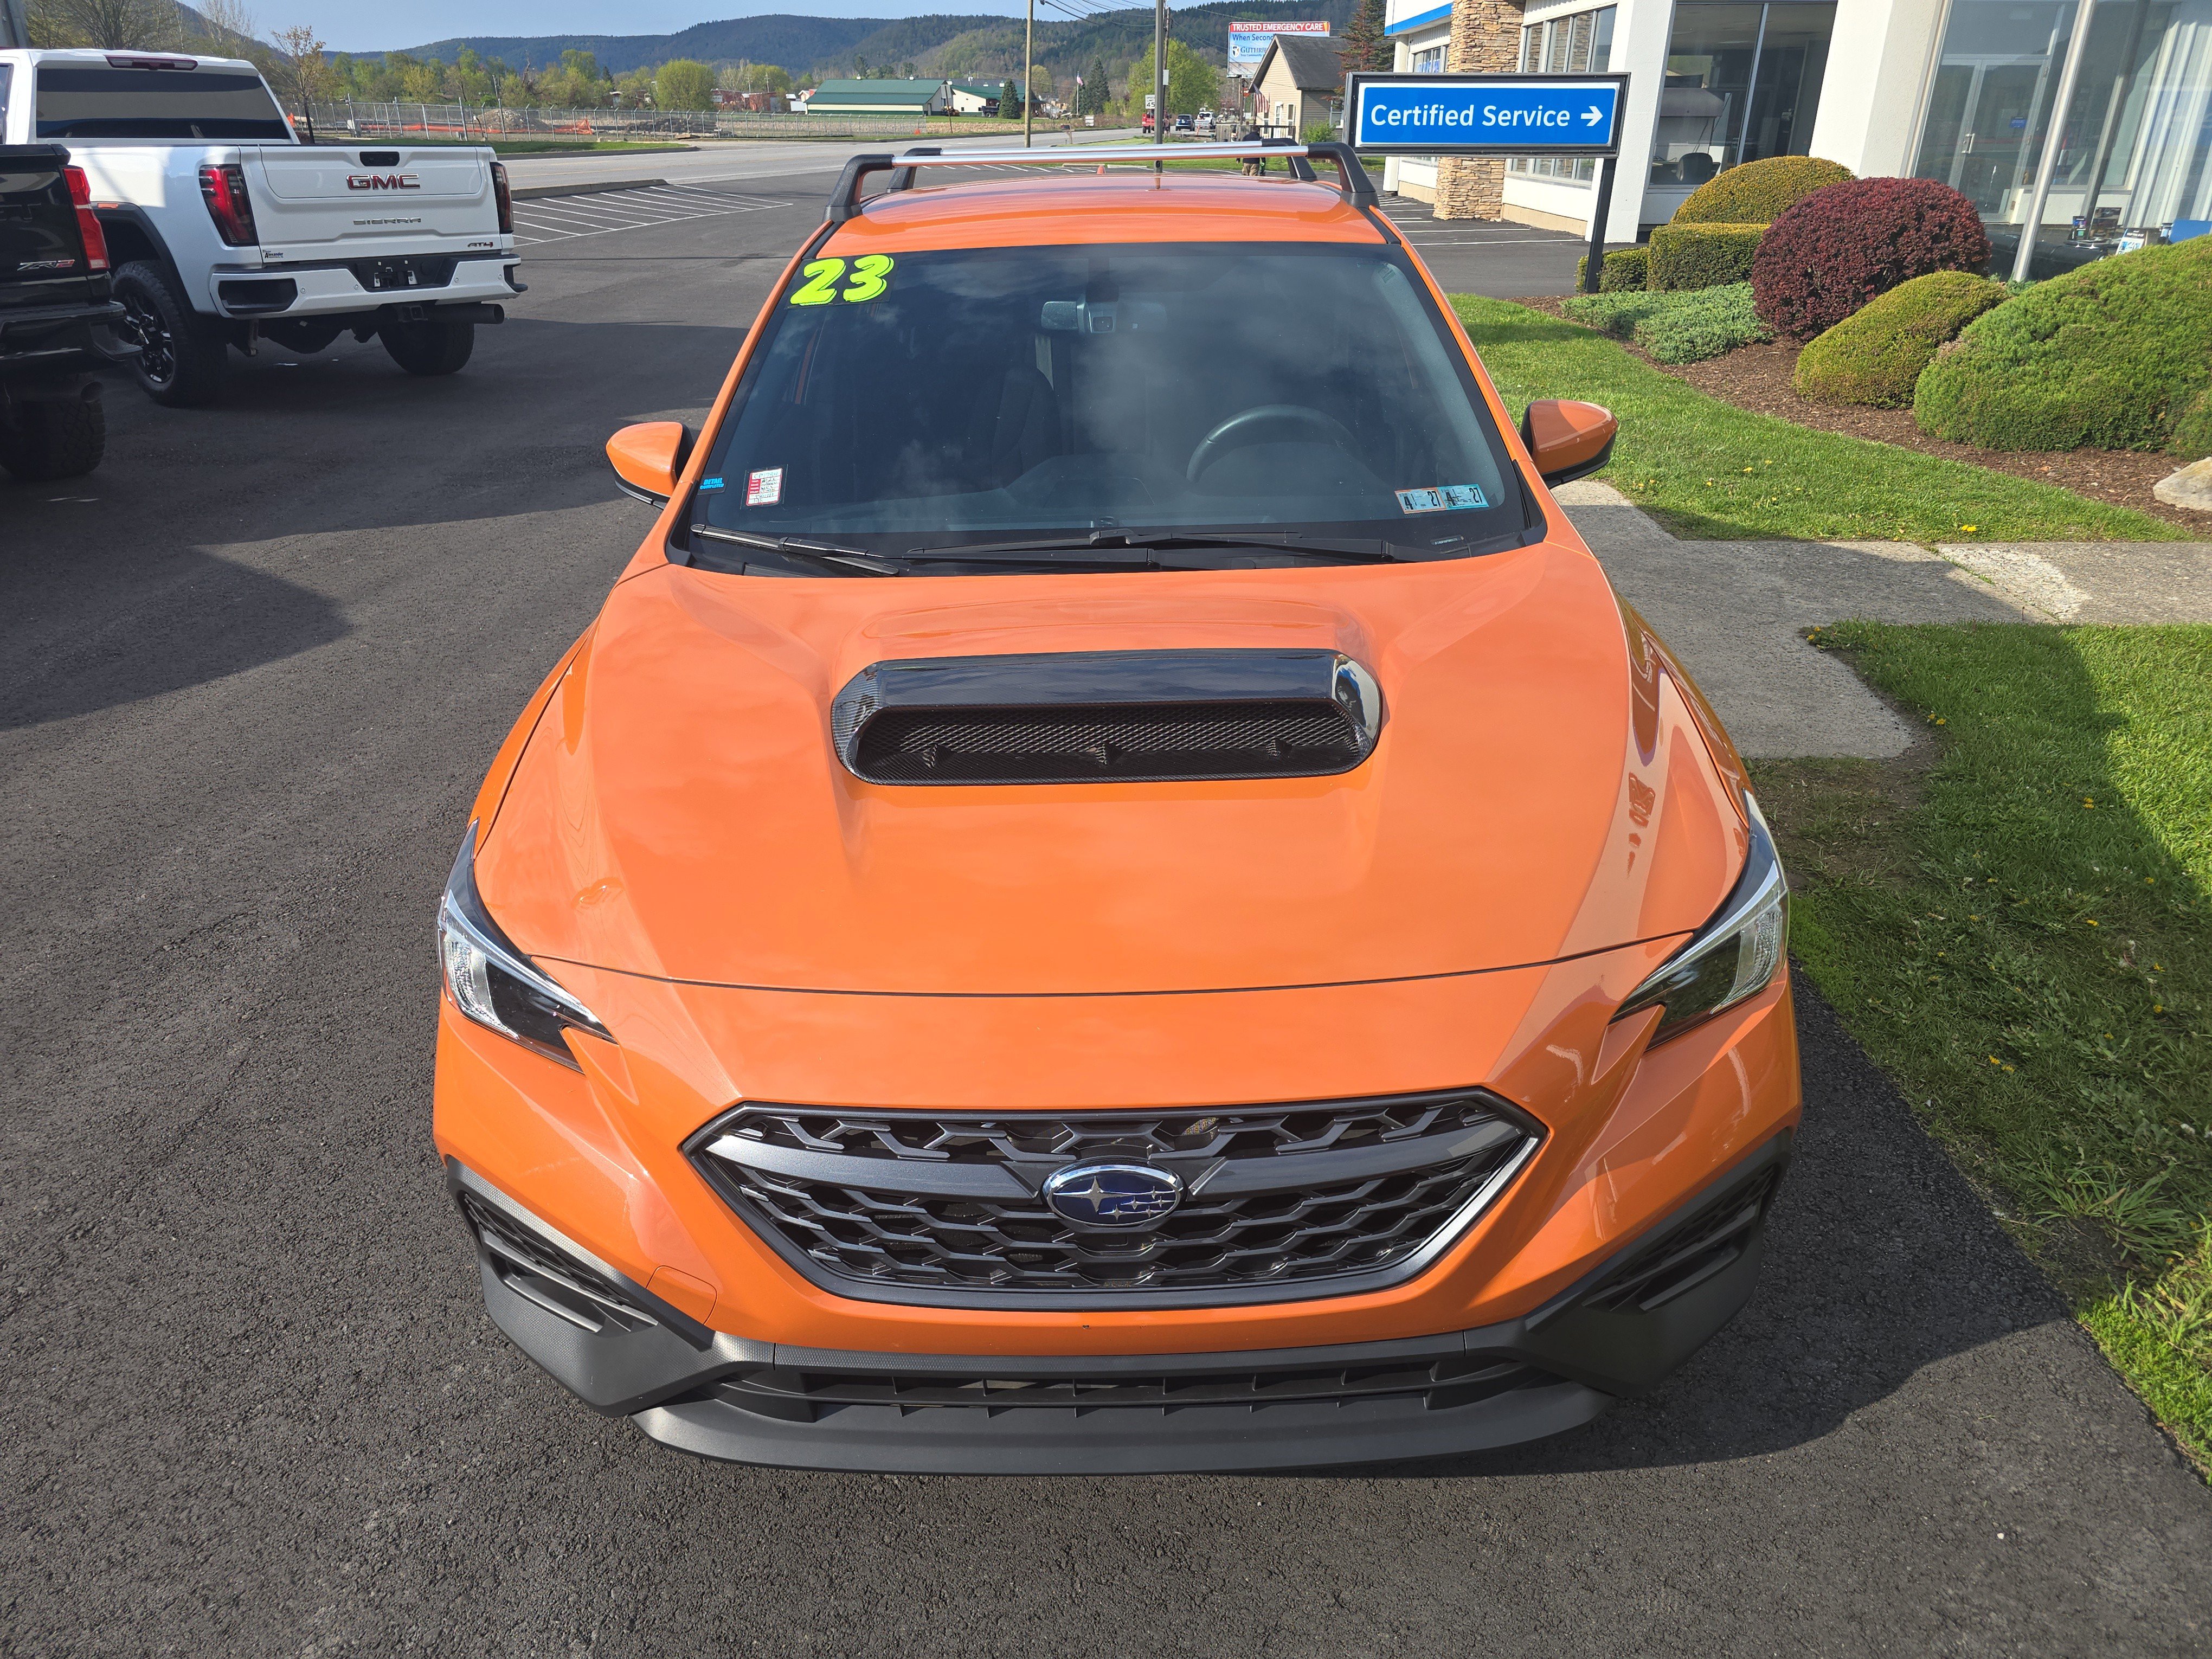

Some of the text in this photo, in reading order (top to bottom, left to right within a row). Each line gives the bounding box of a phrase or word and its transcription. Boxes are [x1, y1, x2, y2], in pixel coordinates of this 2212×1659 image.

[1232, 23, 1262, 31] TRUSTED
[1305, 23, 1323, 31] CARE
[1371, 104, 1570, 127] Certified Service
[346, 173, 421, 190] GMC
[17, 259, 75, 271] ZR2
[790, 255, 894, 306] 23
